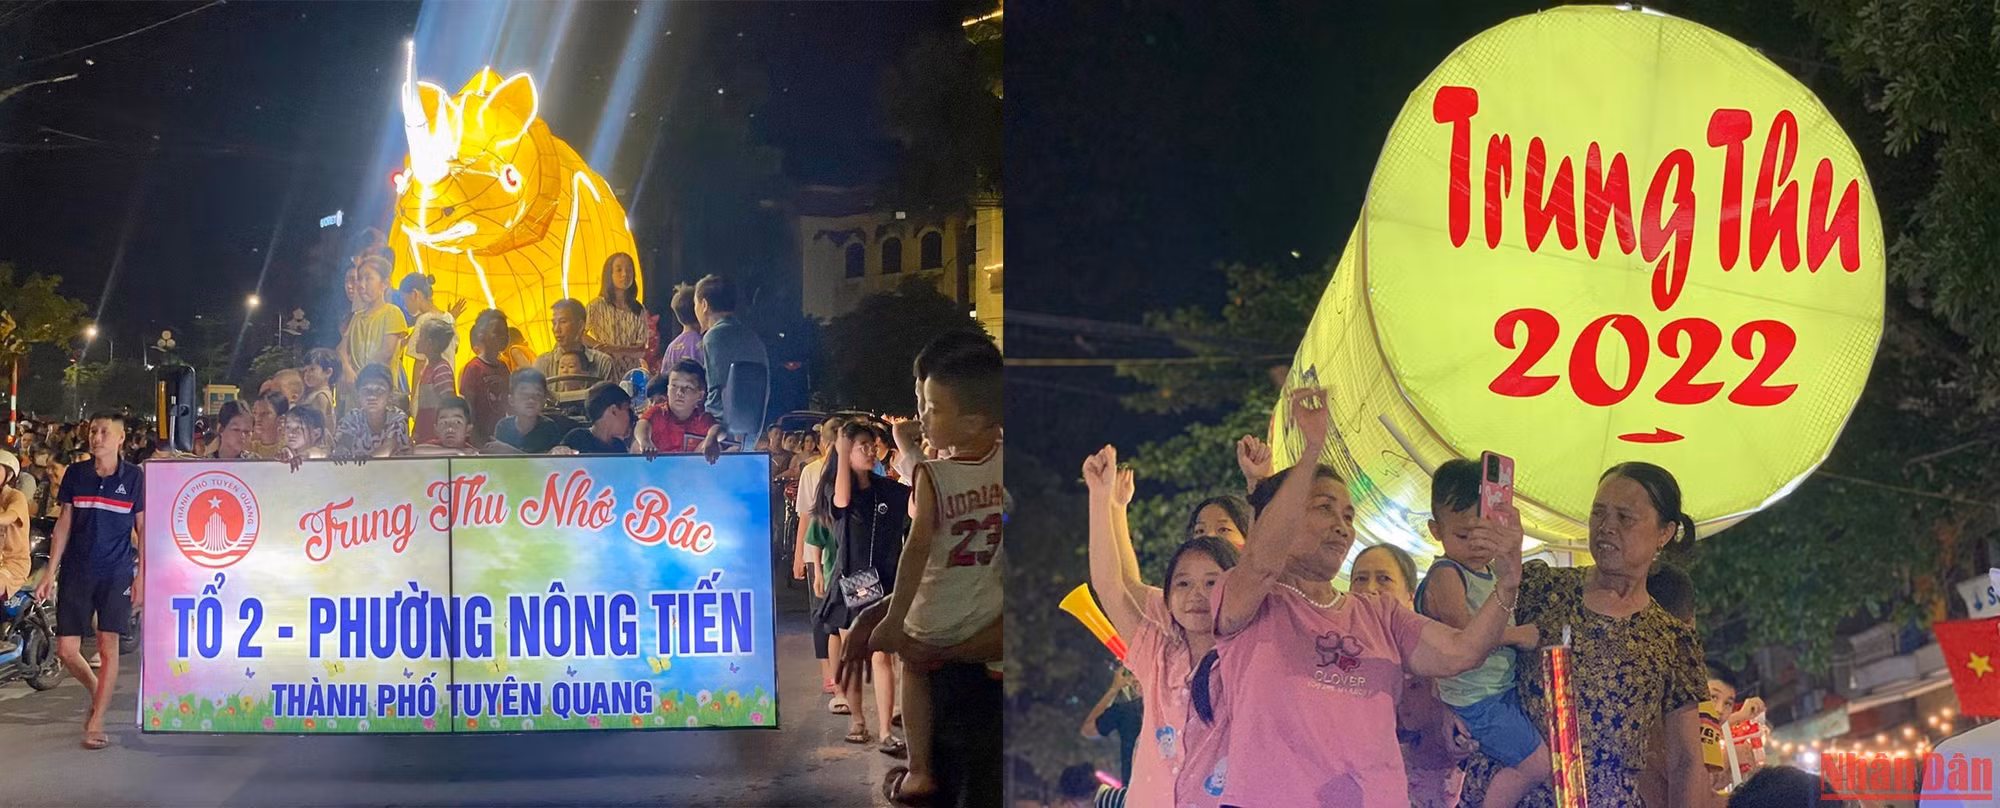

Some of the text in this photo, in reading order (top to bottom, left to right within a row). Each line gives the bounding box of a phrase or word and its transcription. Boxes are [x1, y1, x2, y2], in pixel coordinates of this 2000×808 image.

[1433, 86, 1860, 311] Trung Thu
[1488, 308, 1798, 407] 2022
[240, 492, 255, 525] QUANG
[300, 470, 714, 561] Trung Thu Nhớ Bác
[946, 513, 1002, 568] 23
[172, 573, 225, 659] TỔ
[237, 597, 263, 658] 2
[309, 582, 492, 659] PHƯỜNG
[509, 582, 637, 657] NÔNG
[652, 571, 752, 655] TIẾN
[271, 671, 653, 719] THÀNH PHỐ TUYÊN QUANG
[1315, 670, 1366, 687] CLOVER
